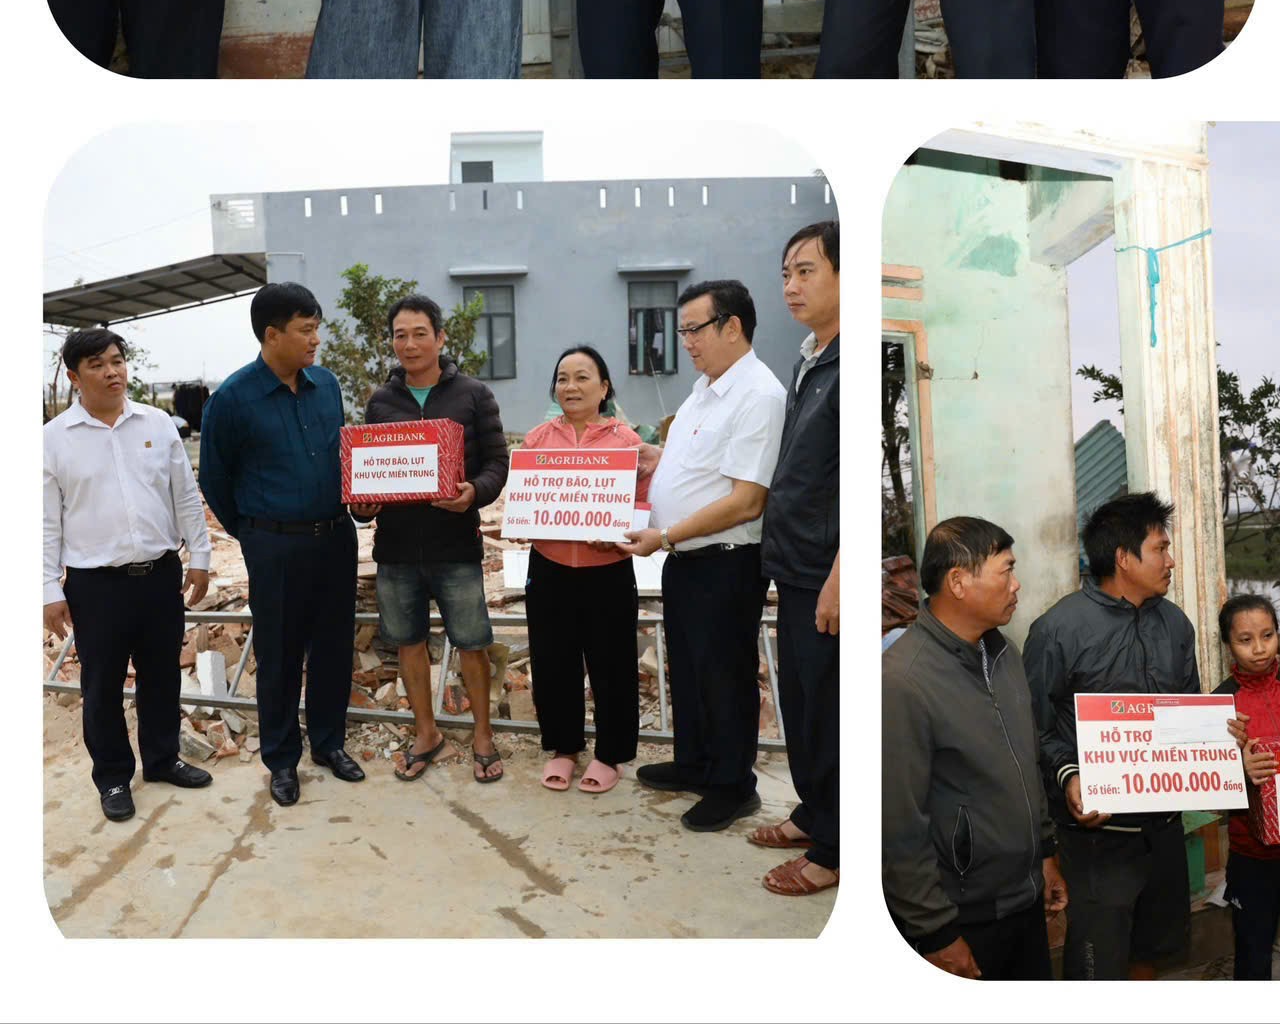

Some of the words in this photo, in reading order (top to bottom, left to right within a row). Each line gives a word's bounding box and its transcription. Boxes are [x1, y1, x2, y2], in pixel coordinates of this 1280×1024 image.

[373, 432, 426, 443] AGRIBANK
[376, 457, 391, 468] TRỢ
[412, 456, 425, 466] LỤT
[548, 456, 609, 465] AGRIBANK
[372, 470, 387, 481] VỰC
[409, 469, 435, 477] TRUNG
[542, 476, 563, 489] TRỢ
[566, 476, 591, 488] BÃO,
[596, 478, 616, 490] LỤT
[510, 492, 532, 502] KHU
[535, 492, 557, 504] VỰC
[592, 493, 631, 503] TRUNG
[534, 510, 612, 527] 10.000.000
[1100, 727, 1121, 743] HỖ
[1124, 730, 1153, 745] TRỢ
[1084, 750, 1115, 764] KHU
[1118, 748, 1149, 766] VỰC
[1152, 746, 1188, 762] MIỀN
[1190, 748, 1238, 761] TRUNG
[1088, 784, 1098, 795] Số
[1122, 772, 1221, 794] 10.000.000
[1224, 780, 1243, 792] đồng
